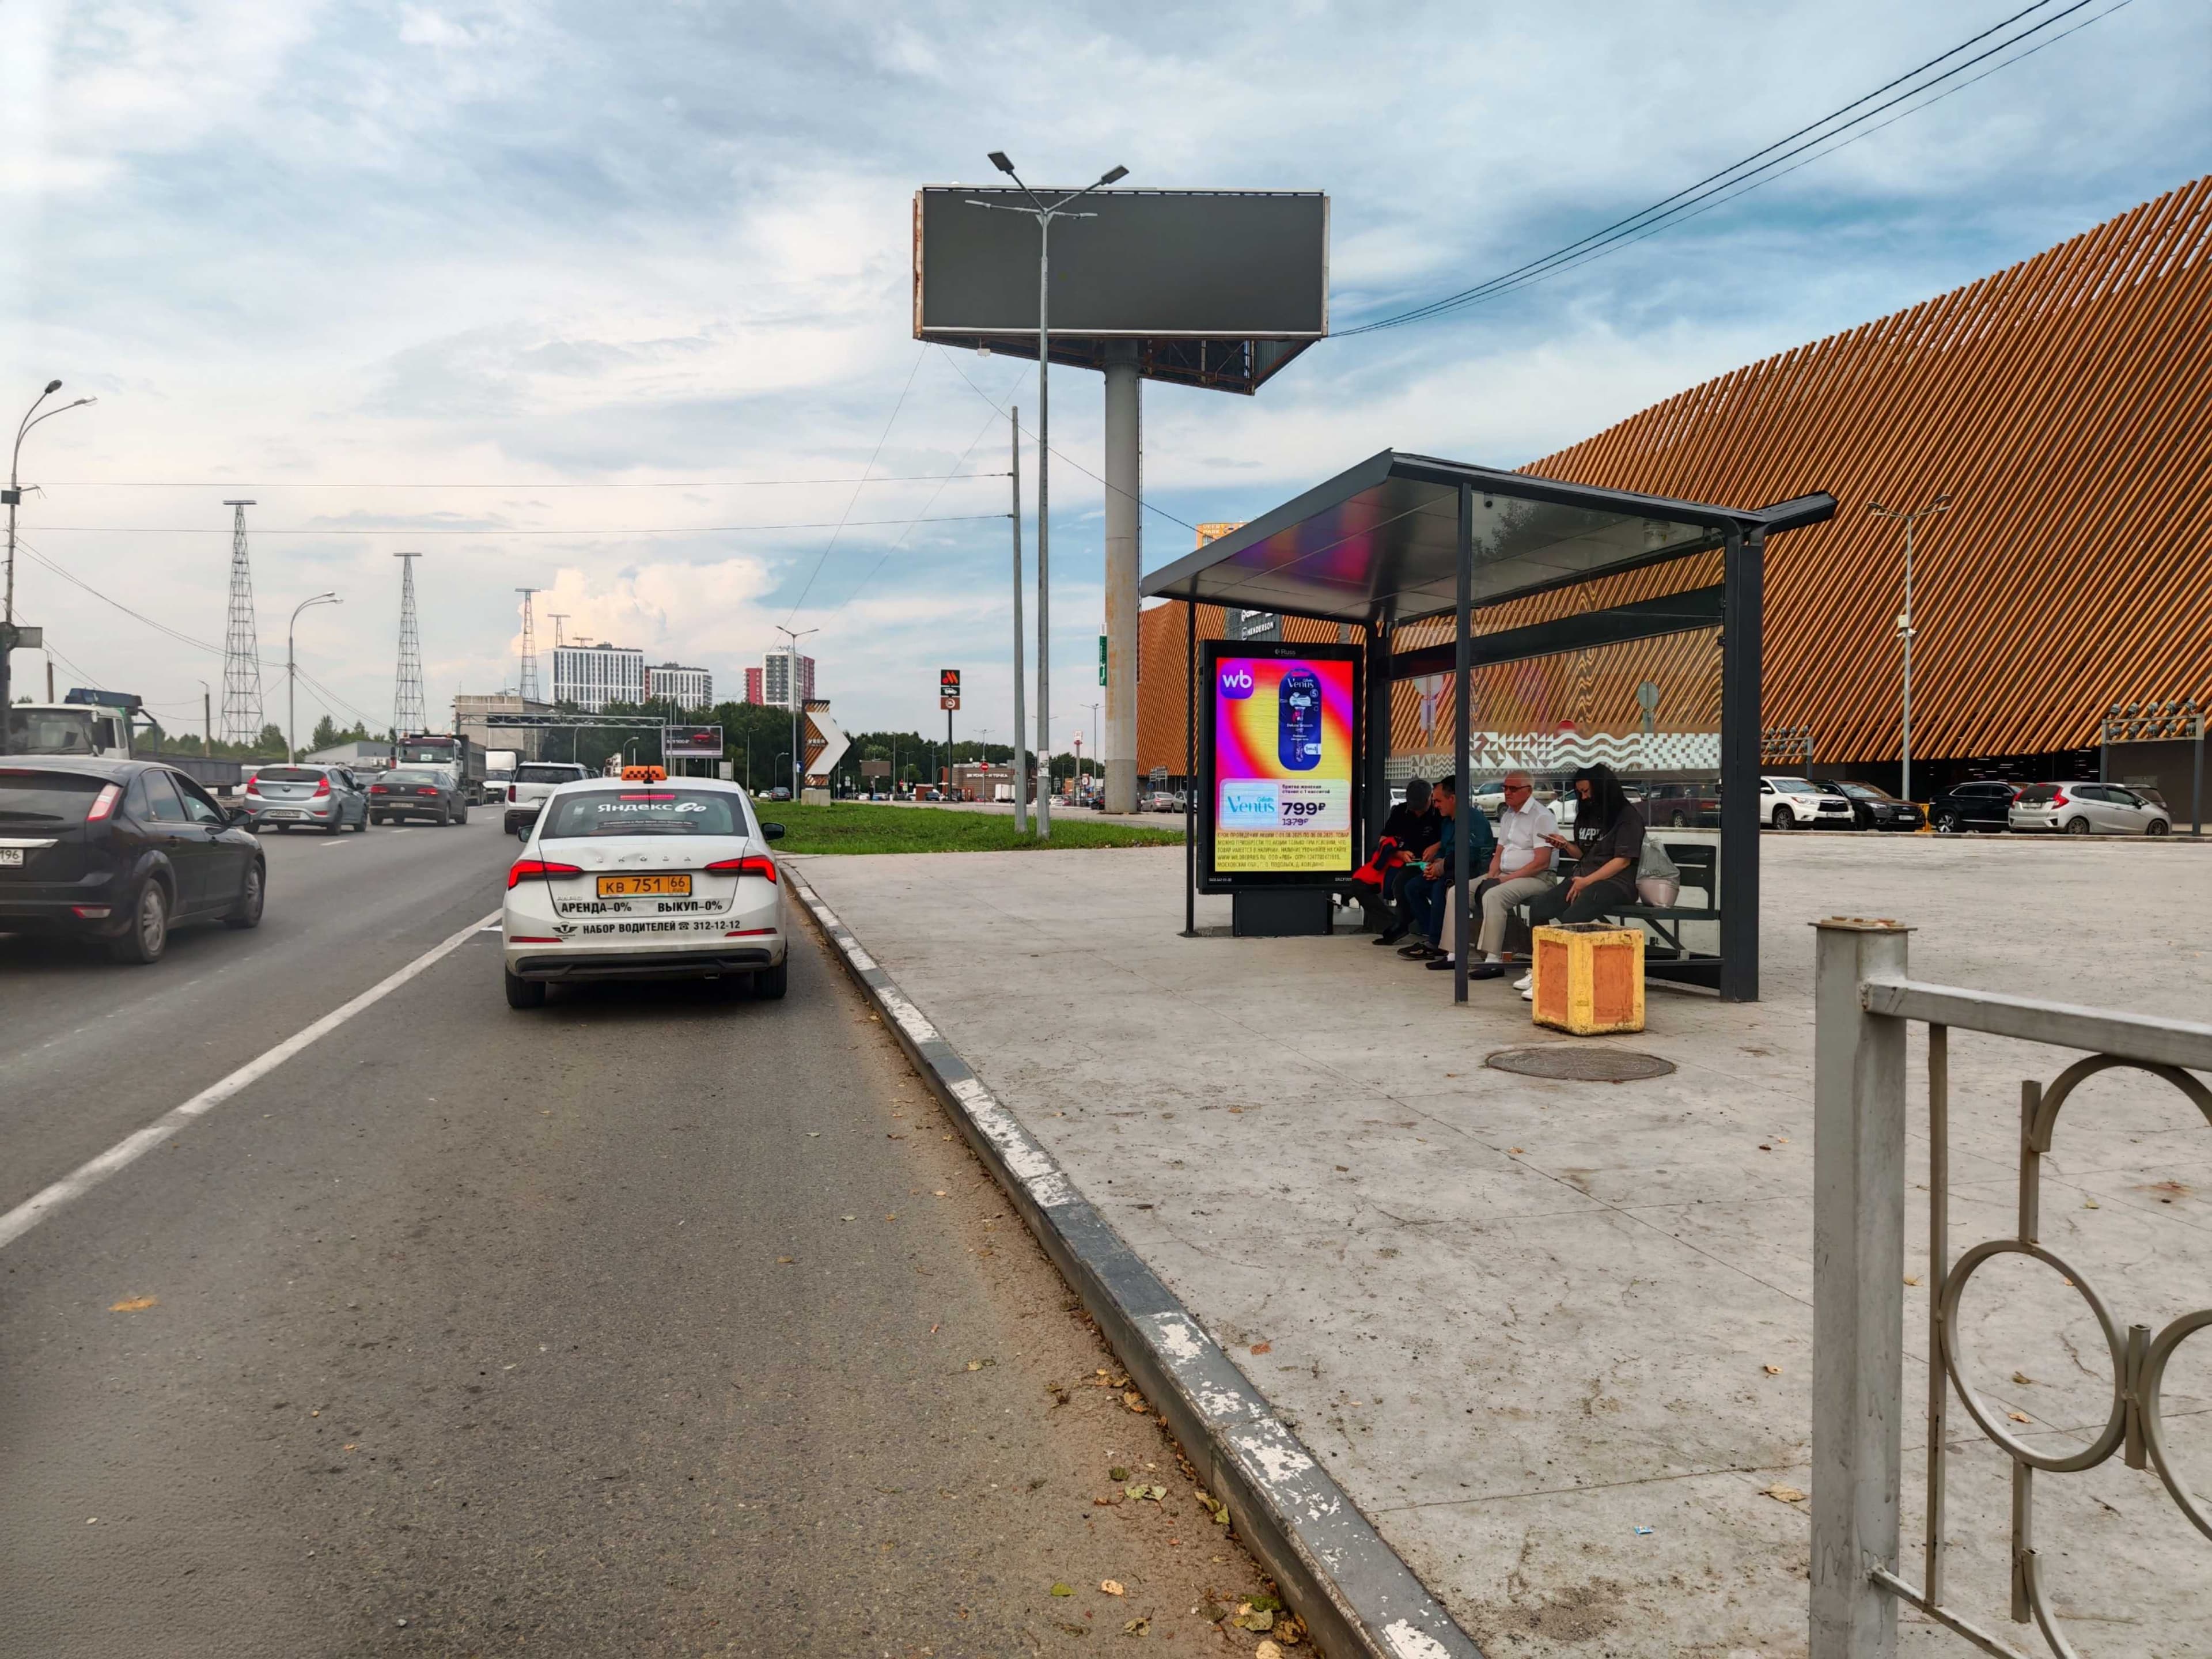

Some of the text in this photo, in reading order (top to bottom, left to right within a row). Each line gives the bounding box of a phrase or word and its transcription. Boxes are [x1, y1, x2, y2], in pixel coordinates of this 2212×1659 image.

[1247, 622, 1273, 636] HENDERSON
[1222, 669, 1252, 688] wb
[1287, 678, 1314, 688] Venus
[598, 802, 707, 812] Яндекс Go
[1228, 796, 1275, 813] Venus
[633, 878, 661, 892] 751
[671, 877, 685, 887] 66
[583, 920, 740, 934] НАБОР ВОДИТЕЛЕЙ 312-12-12
